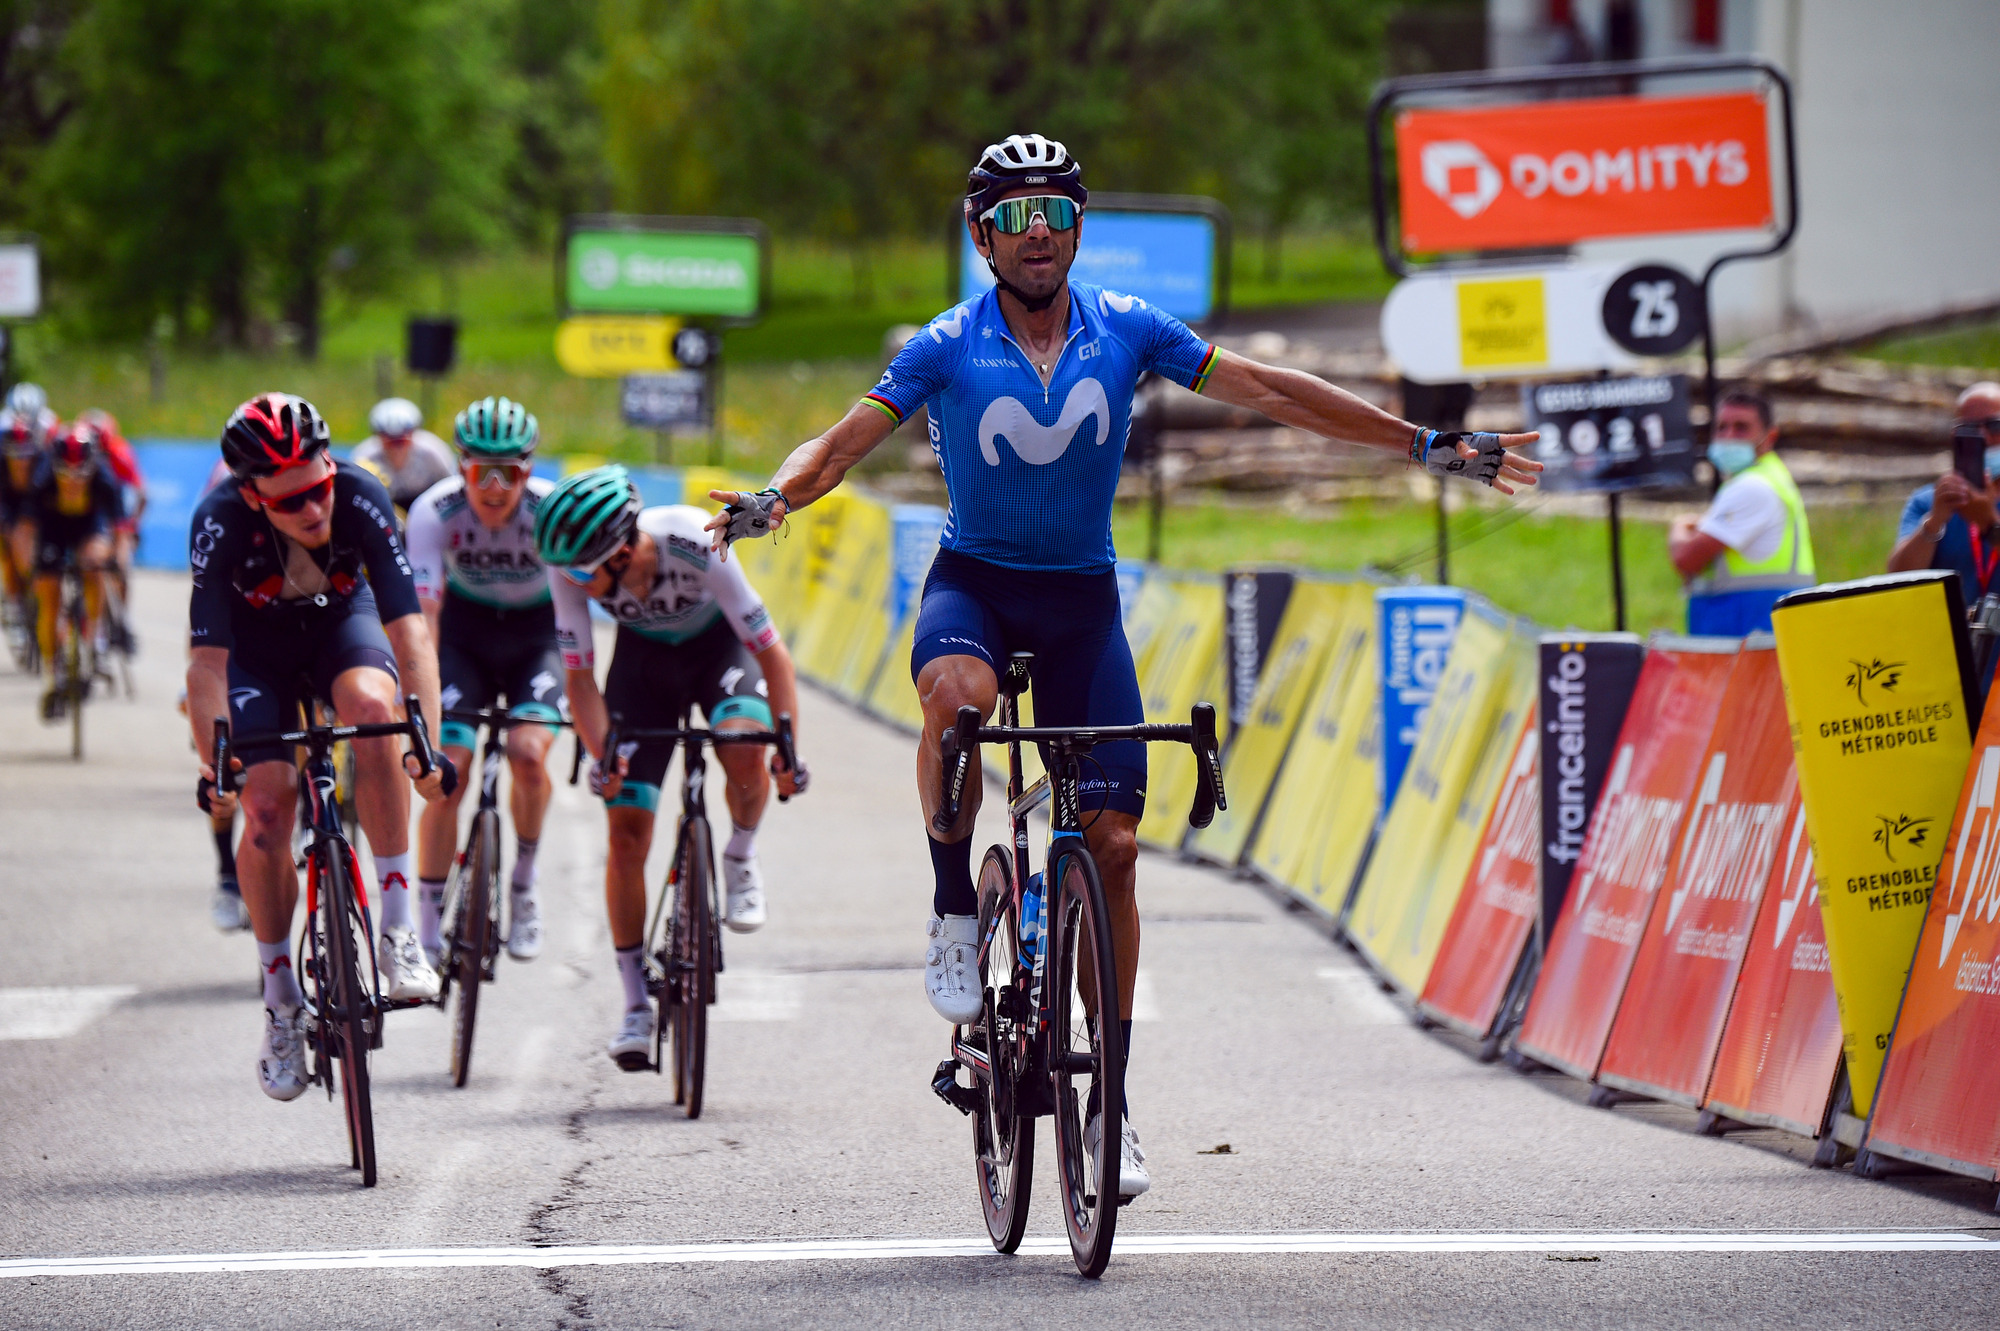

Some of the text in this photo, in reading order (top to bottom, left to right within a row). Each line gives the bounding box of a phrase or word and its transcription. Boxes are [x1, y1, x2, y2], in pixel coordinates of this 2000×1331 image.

[1509, 138, 1749, 199] DOMITYS
[1630, 279, 1680, 339] 25
[972, 357, 1020, 369] CANYON
[1535, 412, 1665, 458] 2021
[192, 514, 225, 589] INEOS
[1819, 703, 1953, 739] GRENOBLEALPES
[1841, 725, 1938, 757] MÉTROPOLE
[951, 750, 968, 802] SRAM
[1207, 749, 1225, 798] SRAM
[1547, 652, 1587, 865] franceinfo
